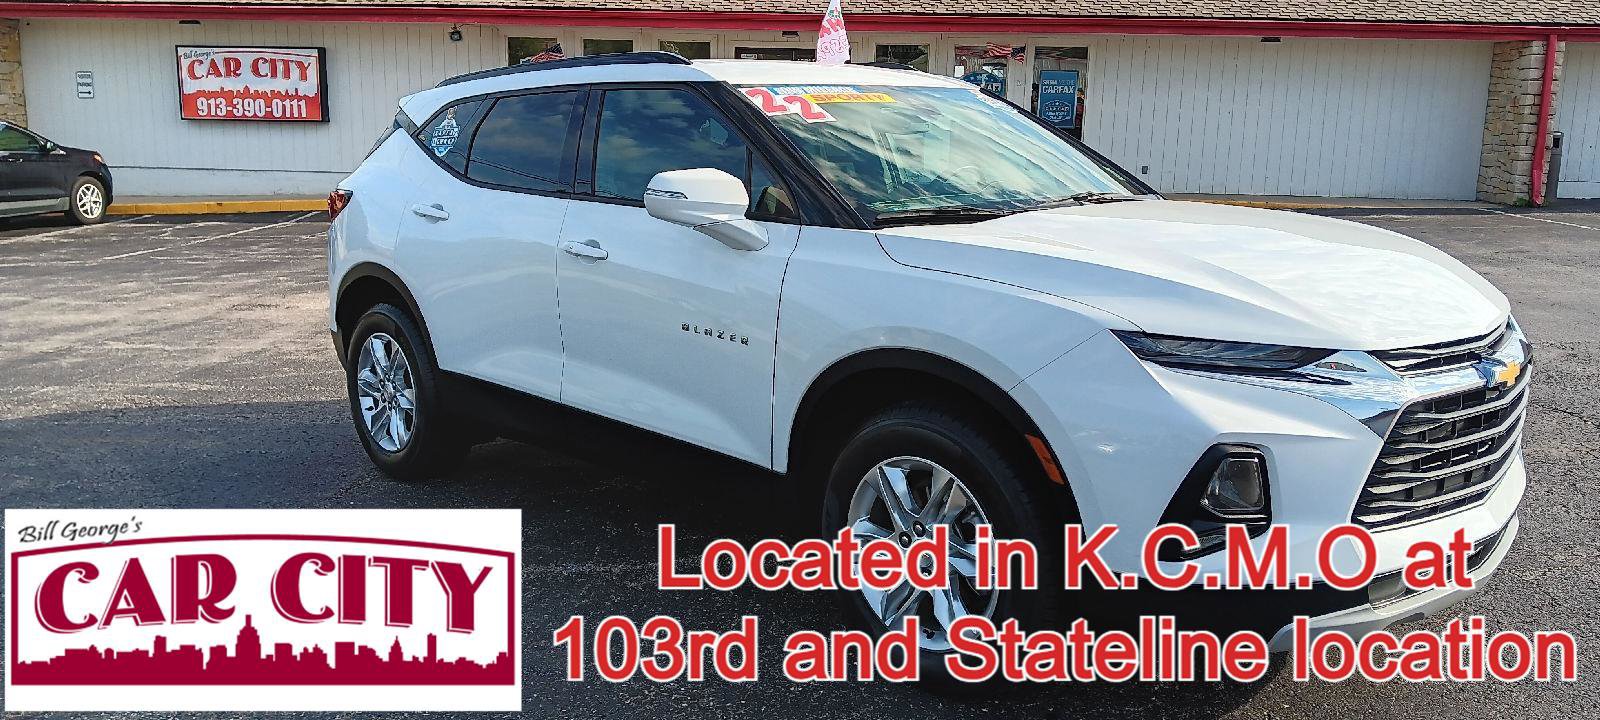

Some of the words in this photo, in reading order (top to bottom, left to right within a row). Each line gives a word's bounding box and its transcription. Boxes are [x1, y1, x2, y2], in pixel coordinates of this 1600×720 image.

[187, 56, 242, 80] CAR
[251, 56, 311, 82] CITY
[810, 92, 886, 103] SPORTY
[1042, 85, 1075, 94] CARFAX
[196, 97, 307, 118] 913-390-0111
[681, 322, 749, 346] BLAZER
